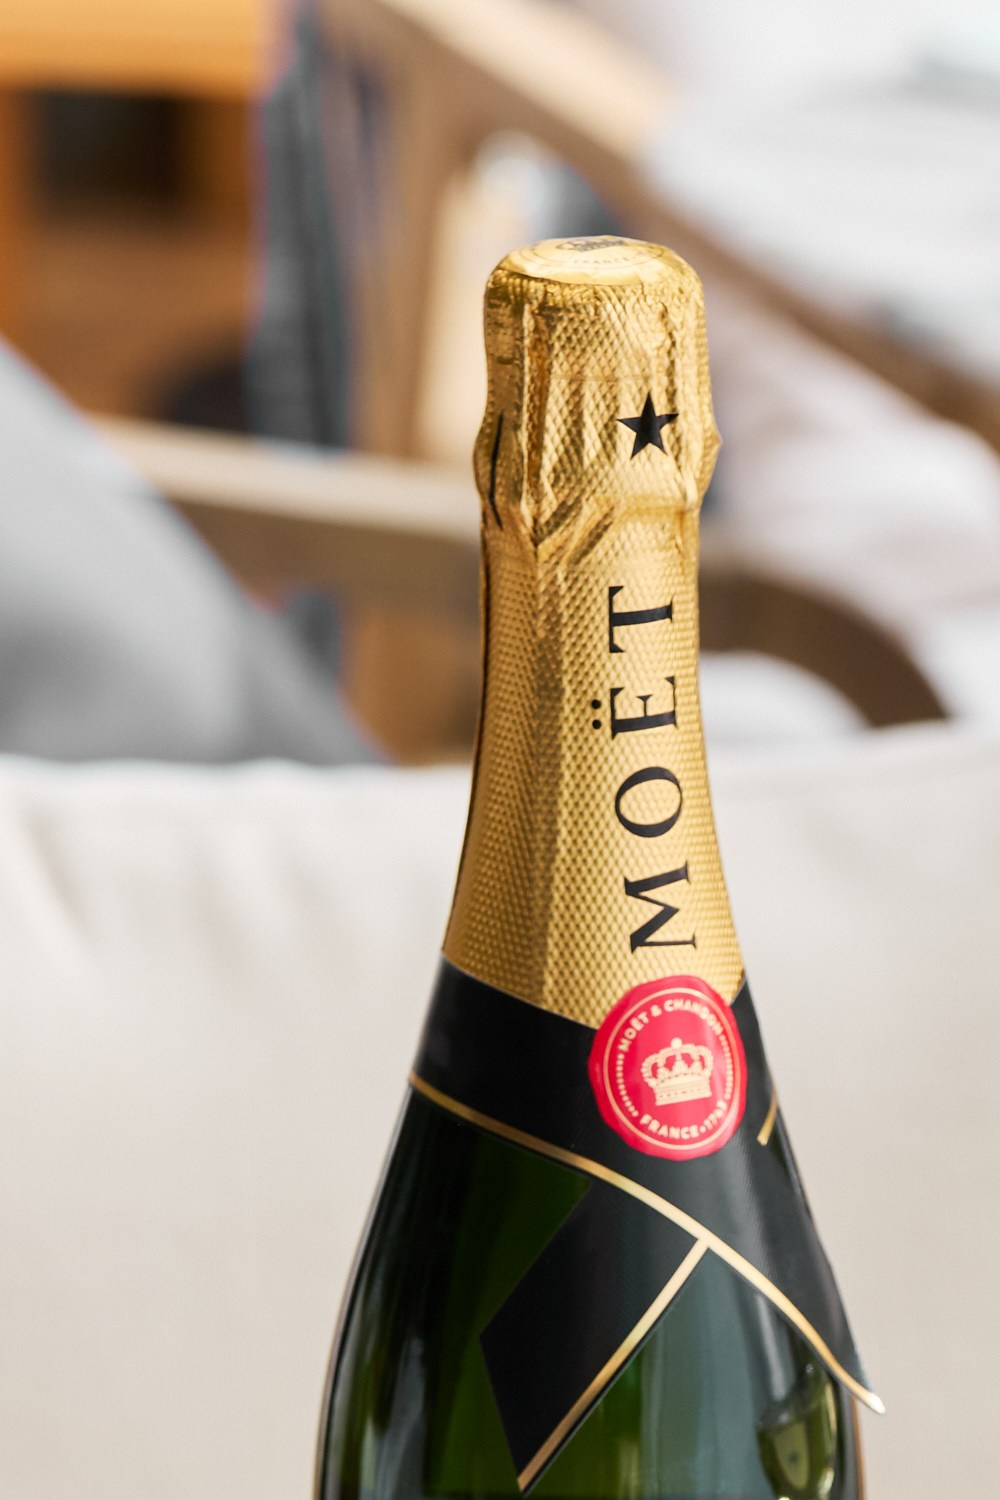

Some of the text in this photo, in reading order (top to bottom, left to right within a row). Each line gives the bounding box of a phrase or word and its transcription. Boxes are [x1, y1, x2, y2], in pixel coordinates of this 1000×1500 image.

[591, 585, 696, 954] MOËT
[650, 1004, 662, 1017] &
[663, 998, 724, 1036] CHANDON
[640, 1113, 699, 1139] FRANCE
